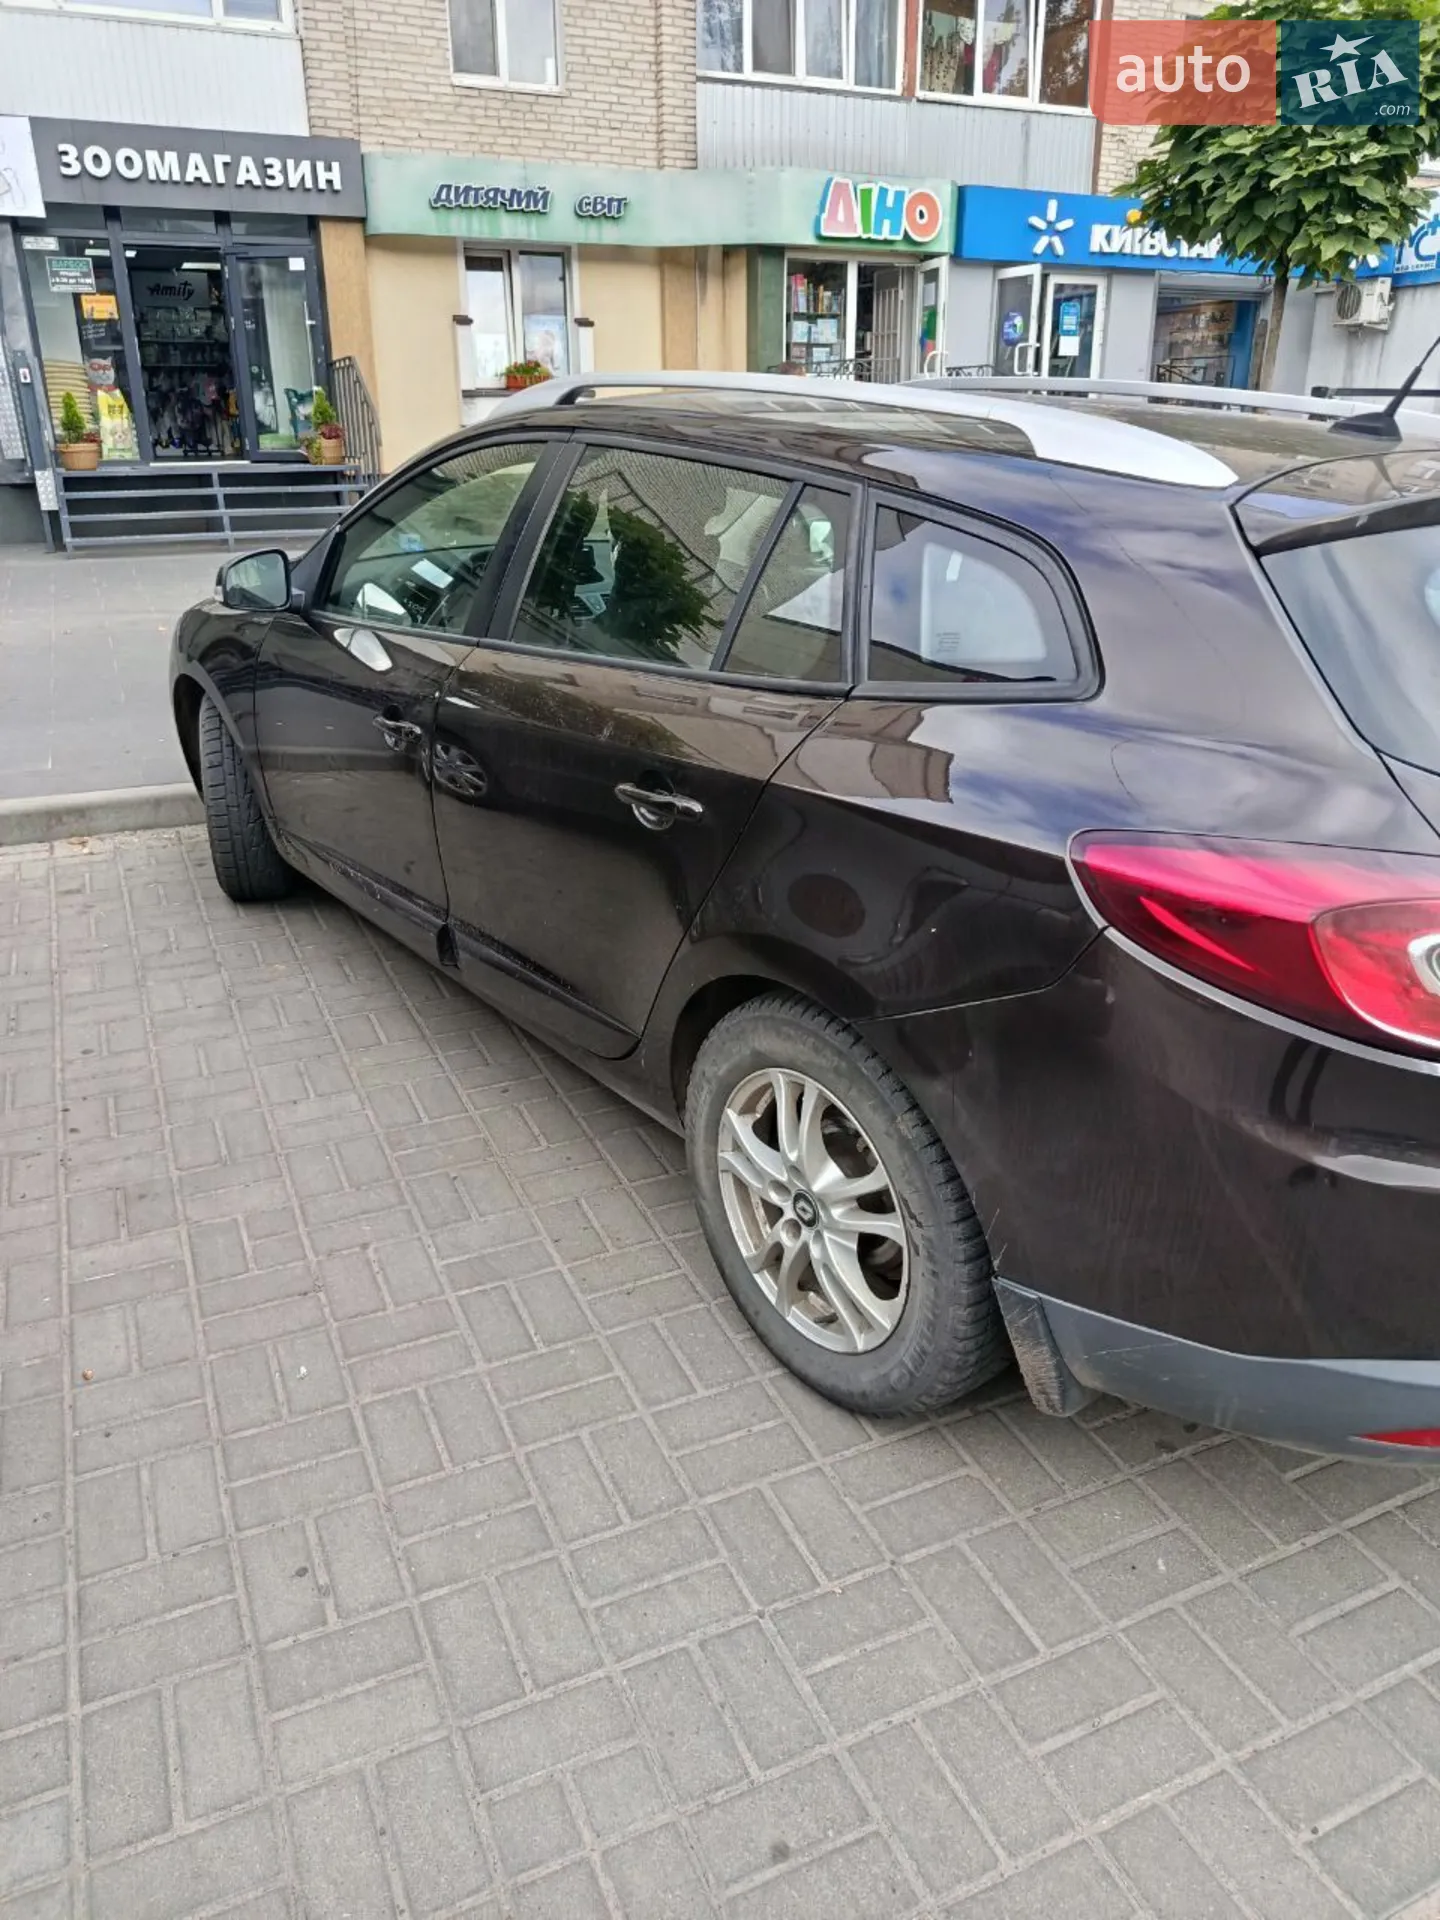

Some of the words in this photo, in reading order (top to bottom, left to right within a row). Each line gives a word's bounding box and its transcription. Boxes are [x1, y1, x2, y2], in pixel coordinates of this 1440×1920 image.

[57, 143, 343, 192] ЗООМАГАЗИН
[431, 183, 551, 213] ДИТЯЧИЙ
[575, 195, 628, 219] СВІТ
[818, 177, 942, 242] ДІНО
